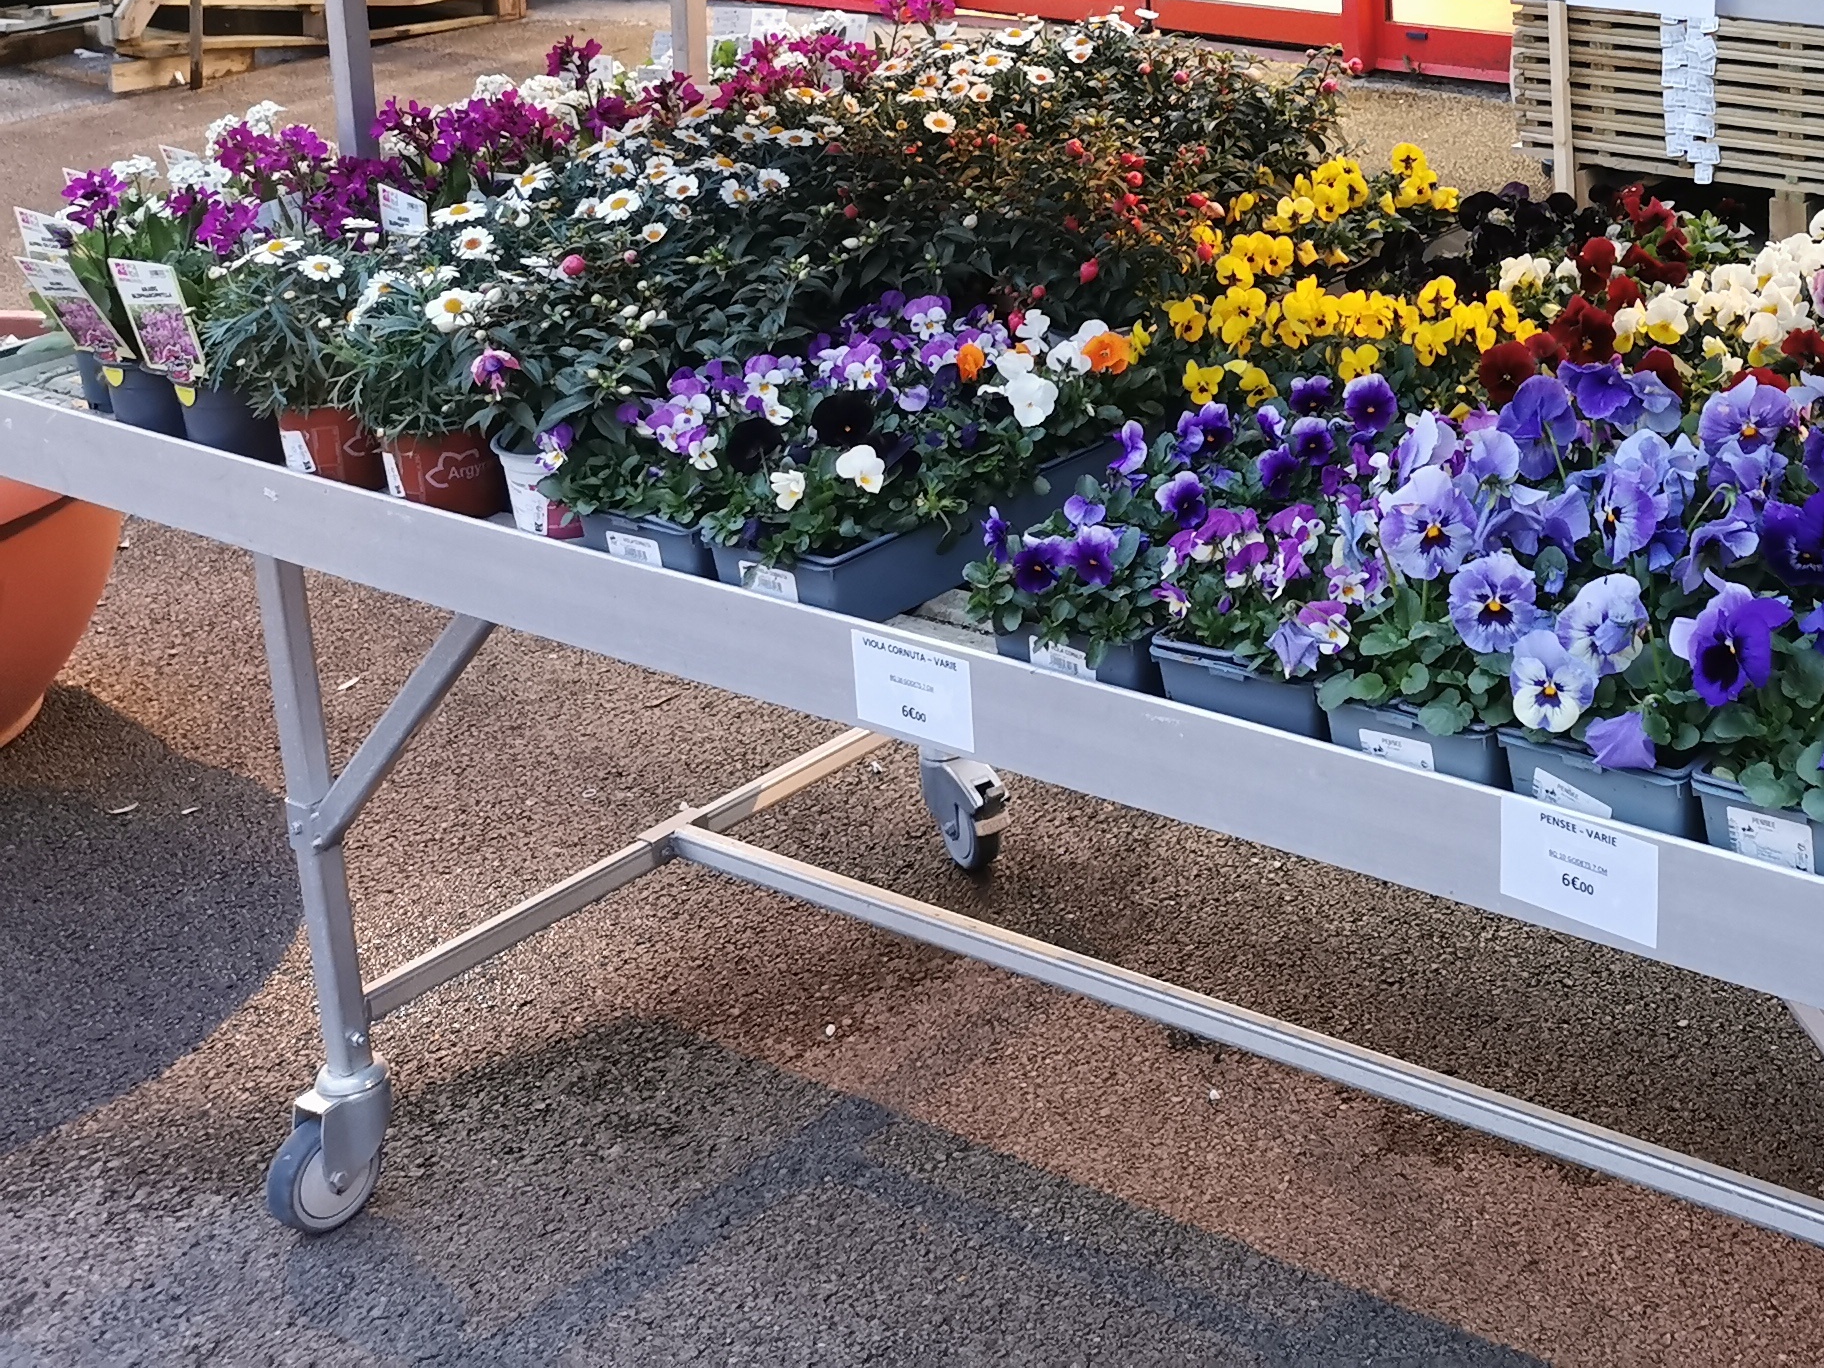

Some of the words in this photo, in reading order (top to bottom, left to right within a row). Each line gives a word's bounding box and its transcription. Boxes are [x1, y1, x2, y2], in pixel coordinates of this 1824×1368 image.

[862, 636, 886, 651] VIOLA
[888, 644, 926, 662] CORNUTA
[934, 657, 957, 671] VARIE
[901, 704, 927, 723] 6€00
[1540, 812, 1577, 834] PENSEE
[1586, 828, 1618, 847] VARIE
[1561, 872, 1594, 896] 6€00
